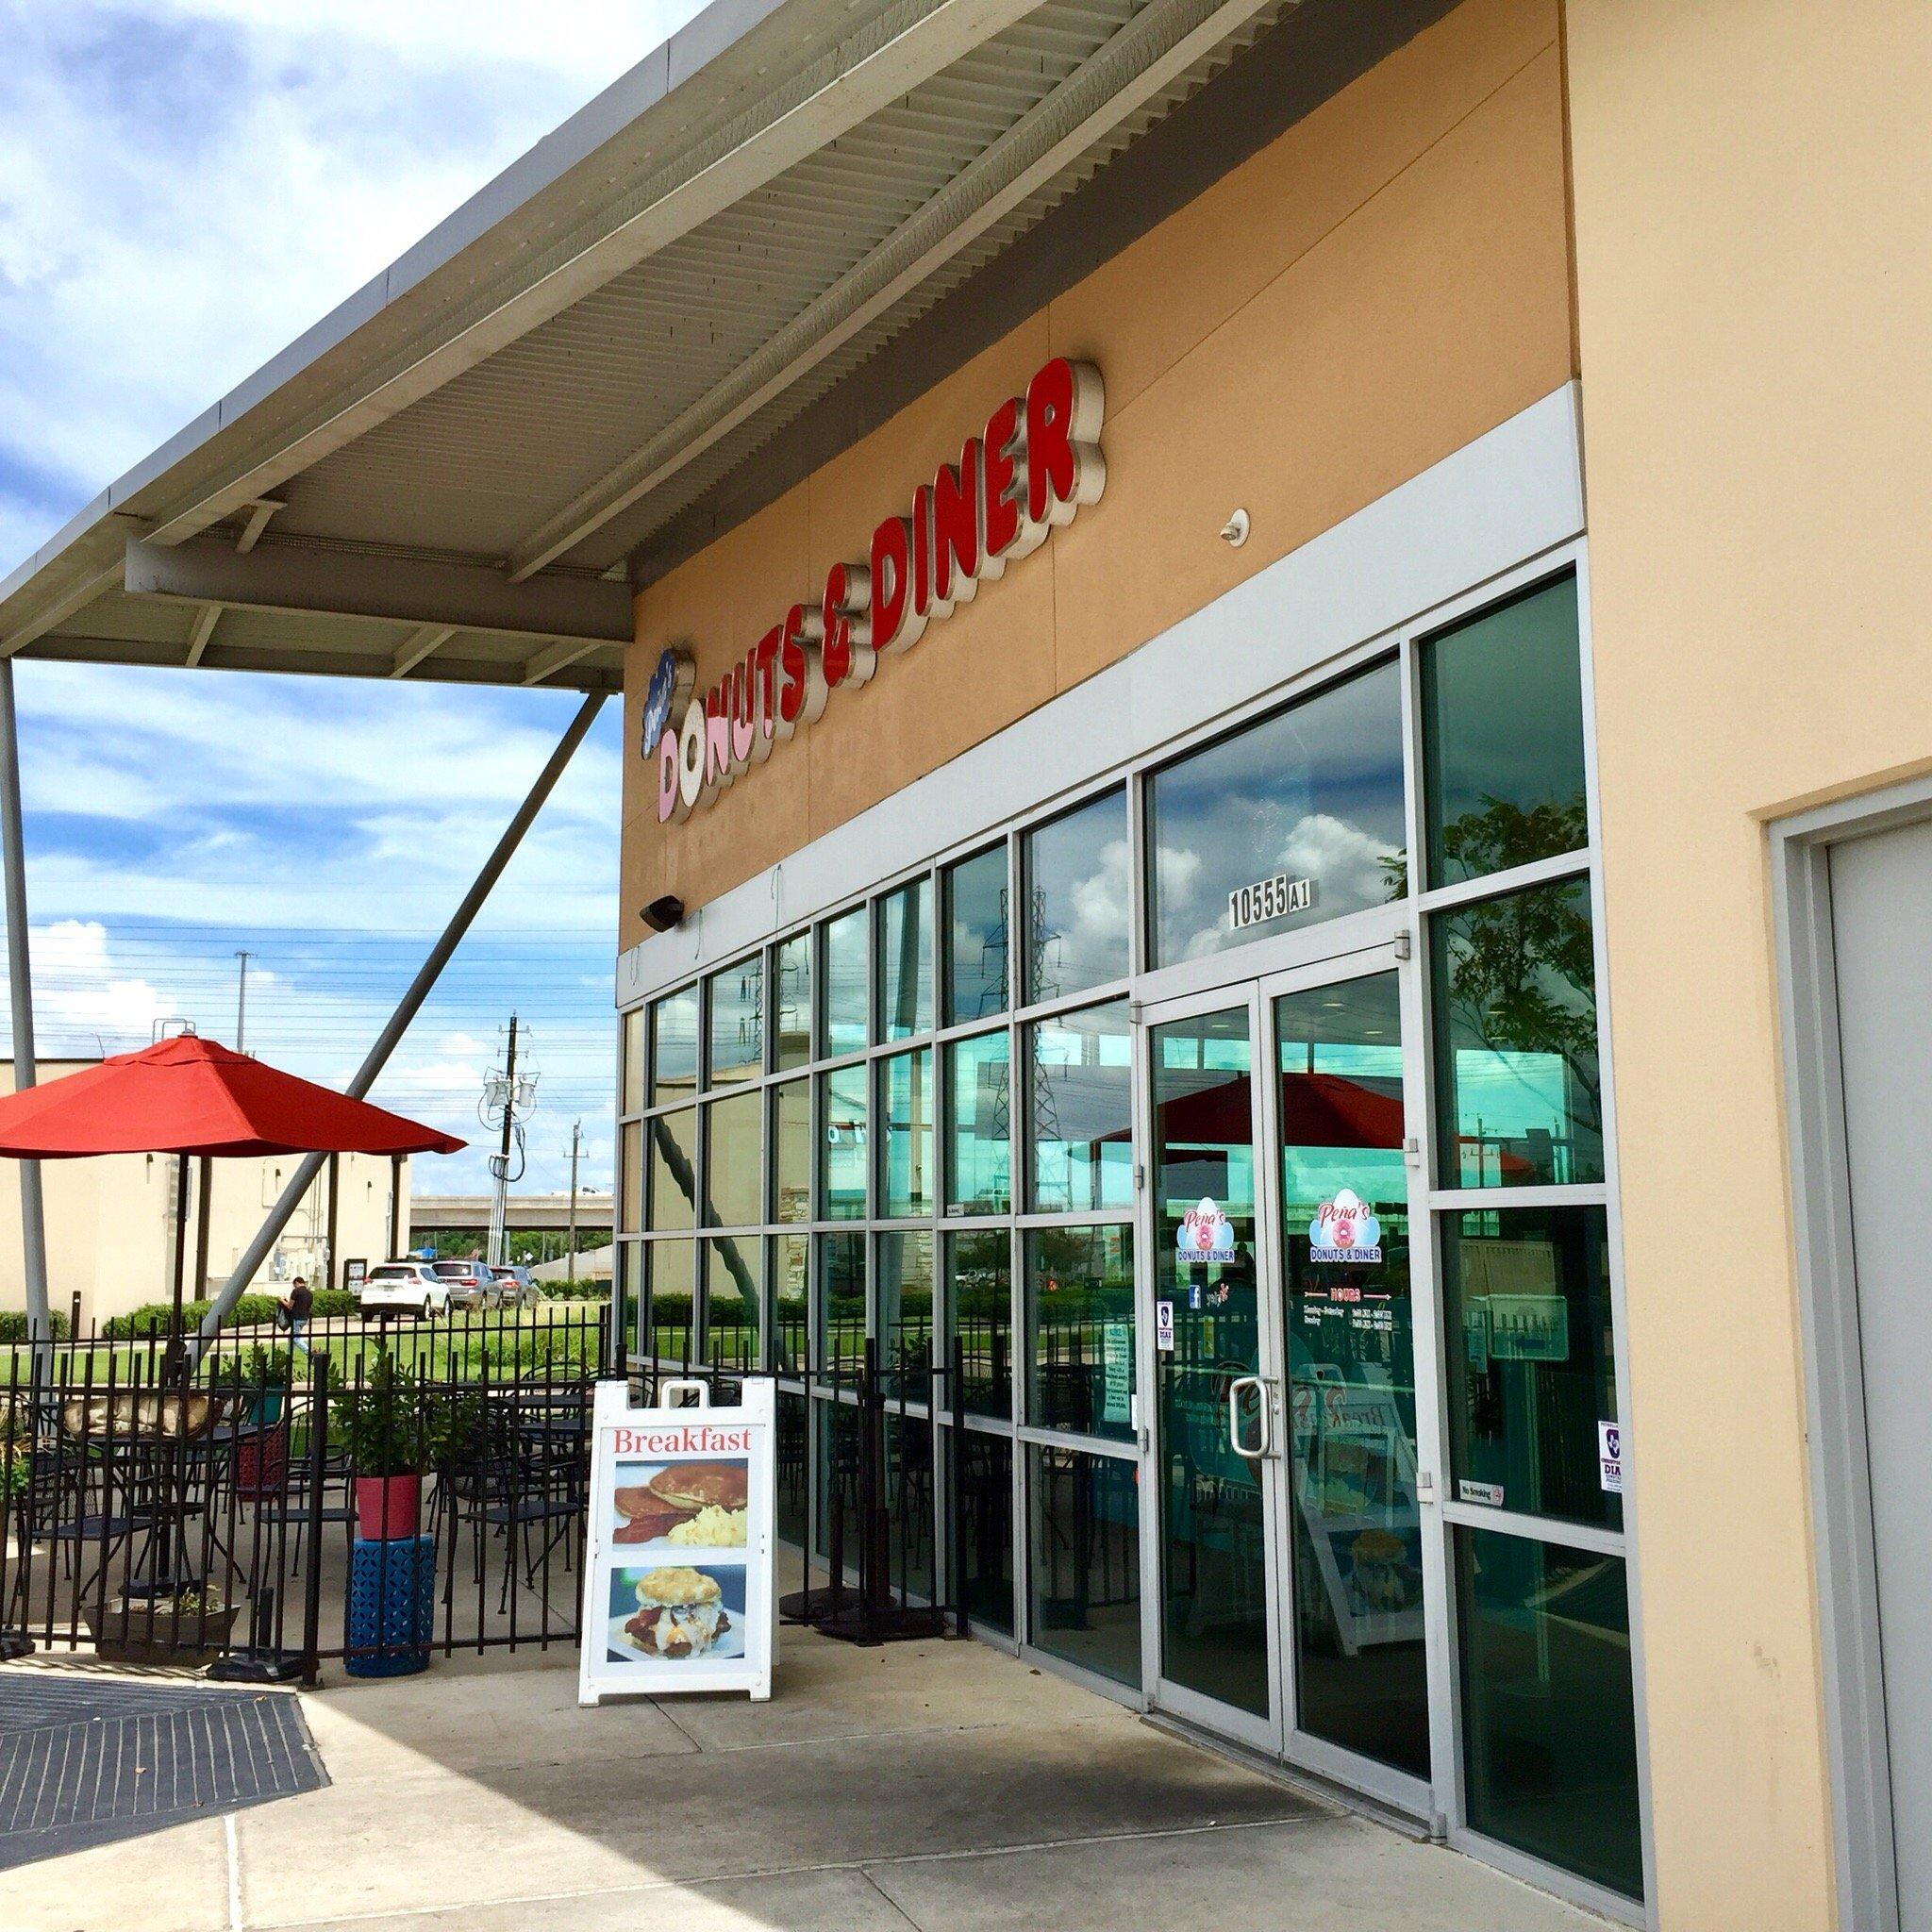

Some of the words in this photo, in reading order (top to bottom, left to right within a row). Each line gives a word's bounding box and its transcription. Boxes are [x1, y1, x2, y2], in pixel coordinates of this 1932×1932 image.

[658, 604, 811, 824] DONUTS
[824, 562, 857, 689] &
[870, 357, 1077, 653] DINER
[1231, 876, 1286, 927] 10555
[1290, 881, 1308, 909] A1
[1179, 1250, 1205, 1261] DONUTS
[1213, 1250, 1234, 1261] DINER
[1311, 1248, 1344, 1260] DONUTS
[1346, 1248, 1353, 1260] &
[1355, 1248, 1380, 1260] DINER
[613, 1426, 752, 1454] Breakfast
[1470, 1487, 1491, 1500] Smoking
